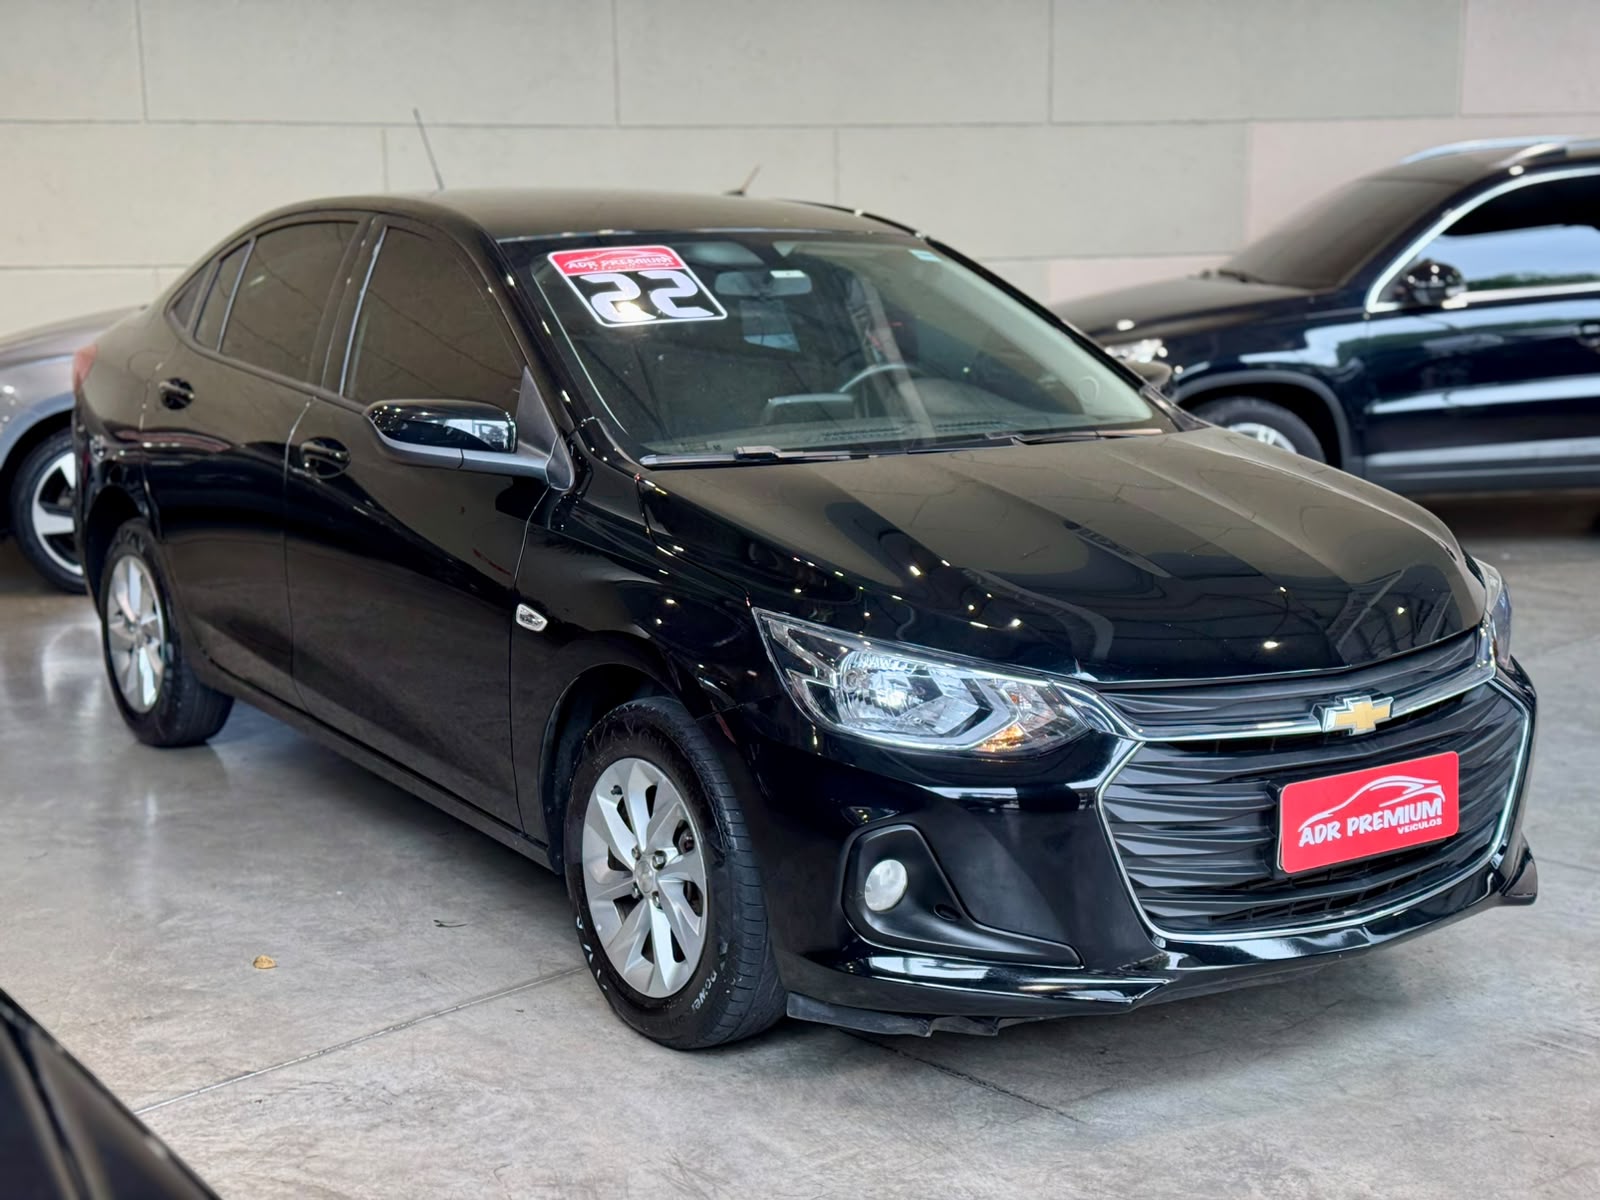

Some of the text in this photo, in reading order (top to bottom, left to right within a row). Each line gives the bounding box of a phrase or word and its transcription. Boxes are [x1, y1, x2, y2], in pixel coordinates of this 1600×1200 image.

[580, 269, 714, 323] 22
[1298, 798, 1442, 847] ADR PREMIUM
[1397, 817, 1442, 834] VEICULOS
